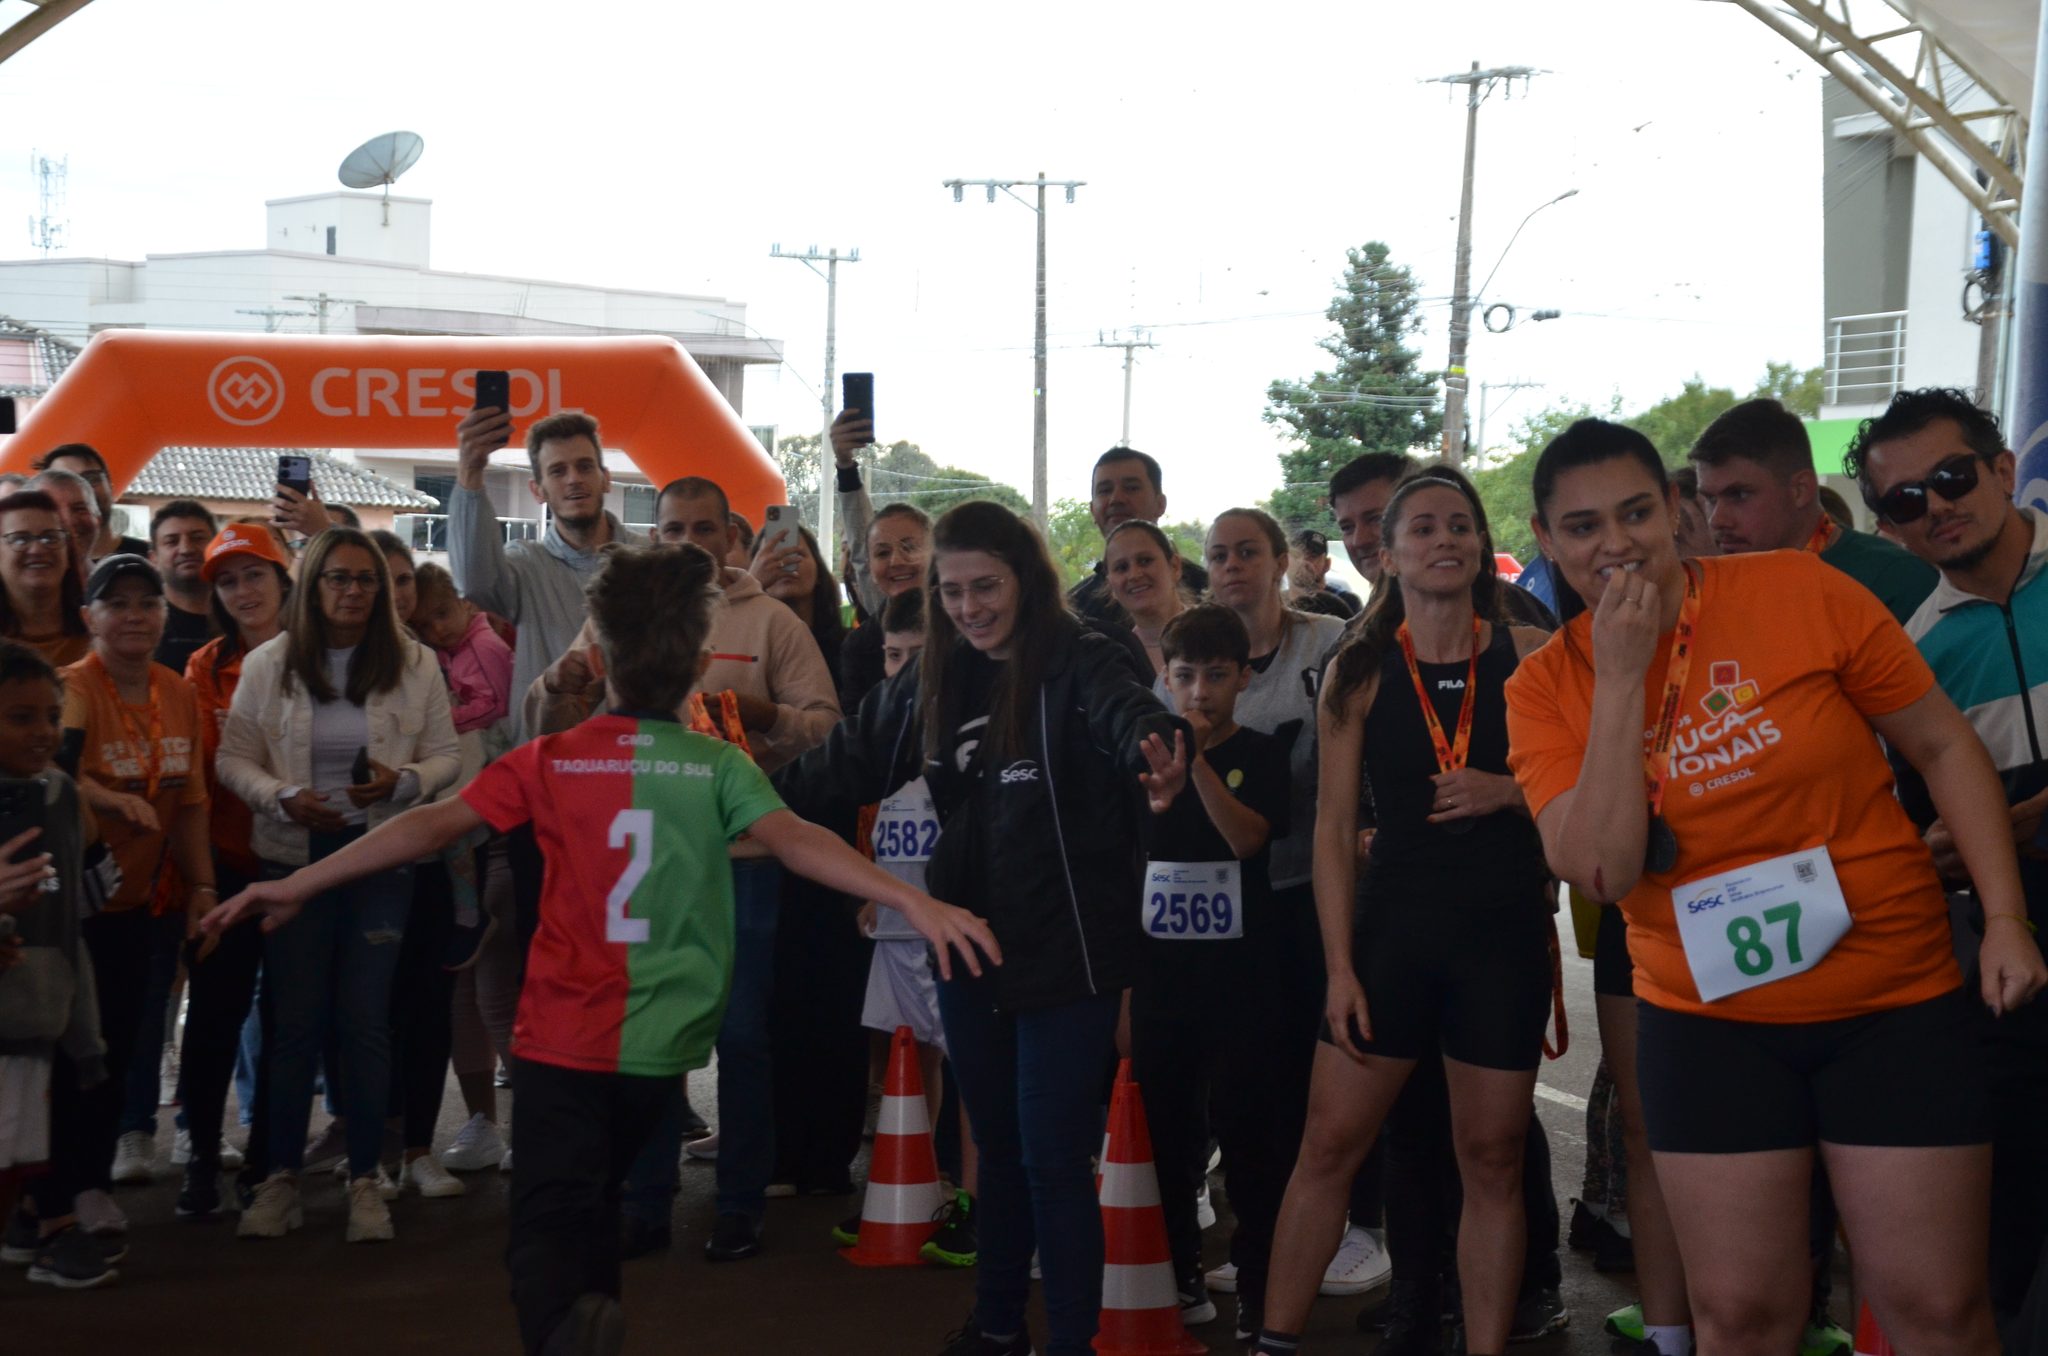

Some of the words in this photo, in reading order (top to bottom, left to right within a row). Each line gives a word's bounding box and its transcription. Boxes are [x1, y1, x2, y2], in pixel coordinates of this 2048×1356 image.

[310, 367, 584, 417] CRESOL
[1438, 679, 1465, 690] FILA
[617, 734, 655, 746] CMD
[1670, 719, 1782, 779] IONAIS
[655, 760, 680, 774] DO
[684, 762, 715, 777] SUL
[1706, 767, 1755, 790] CRESOL
[877, 819, 938, 857] 2582
[606, 809, 654, 943] 2
[1150, 891, 1233, 934] 2569
[1726, 900, 1803, 976] 87
